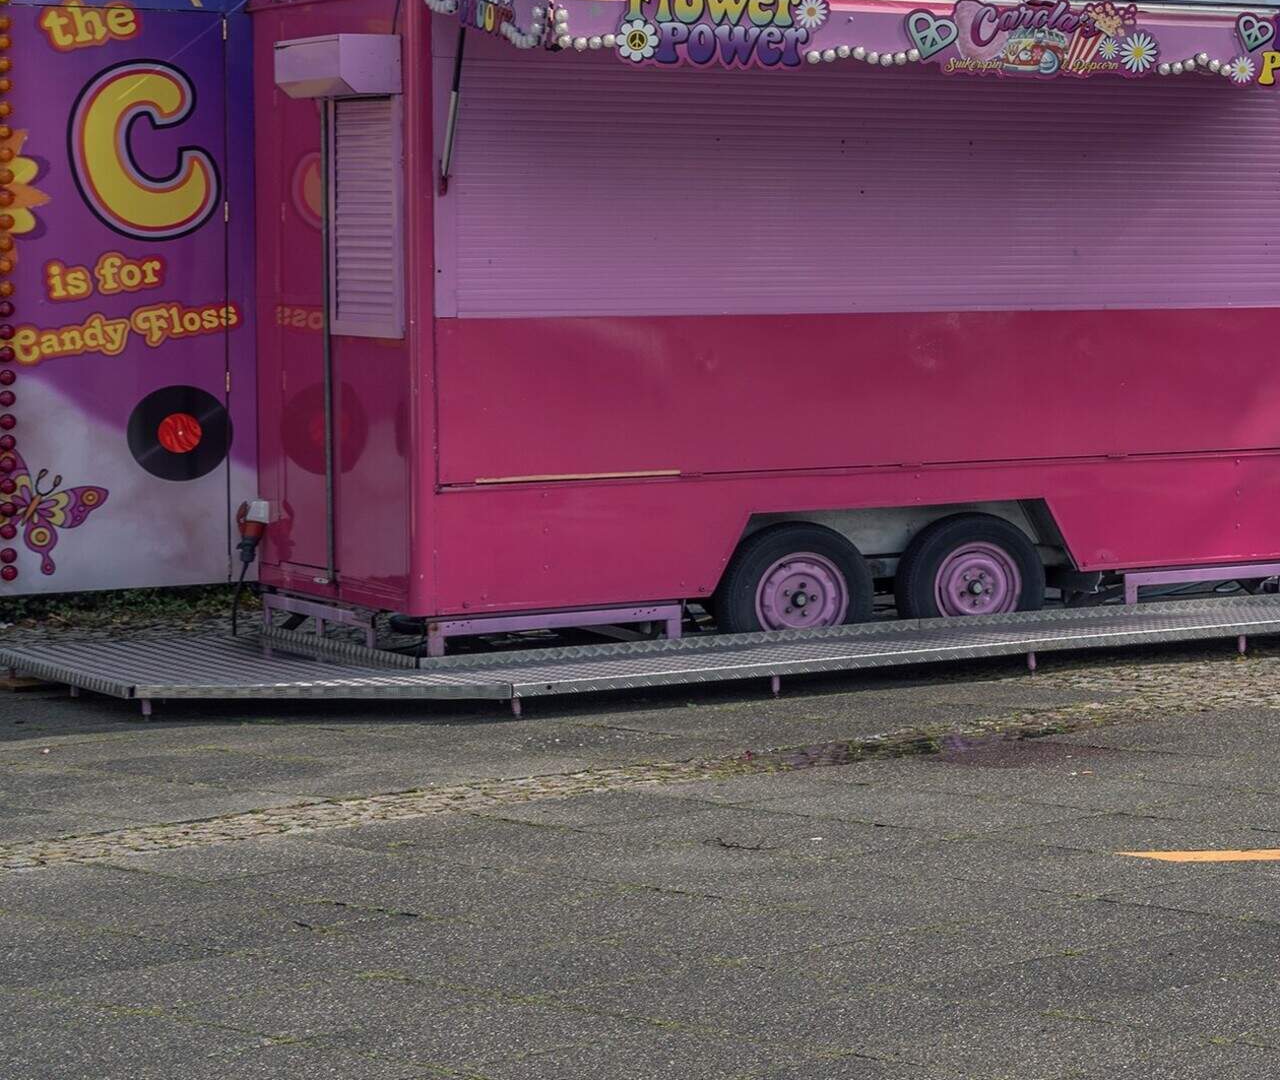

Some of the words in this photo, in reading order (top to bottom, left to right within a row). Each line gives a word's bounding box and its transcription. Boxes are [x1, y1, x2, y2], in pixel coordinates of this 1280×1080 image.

[656, 22, 811, 66] Power
[970, 1, 1096, 47] Carola's
[74, 65, 217, 235] C
[49, 265, 89, 298] is
[97, 256, 161, 292] for
[13, 317, 127, 361] Candy
[132, 304, 239, 347] Floss
